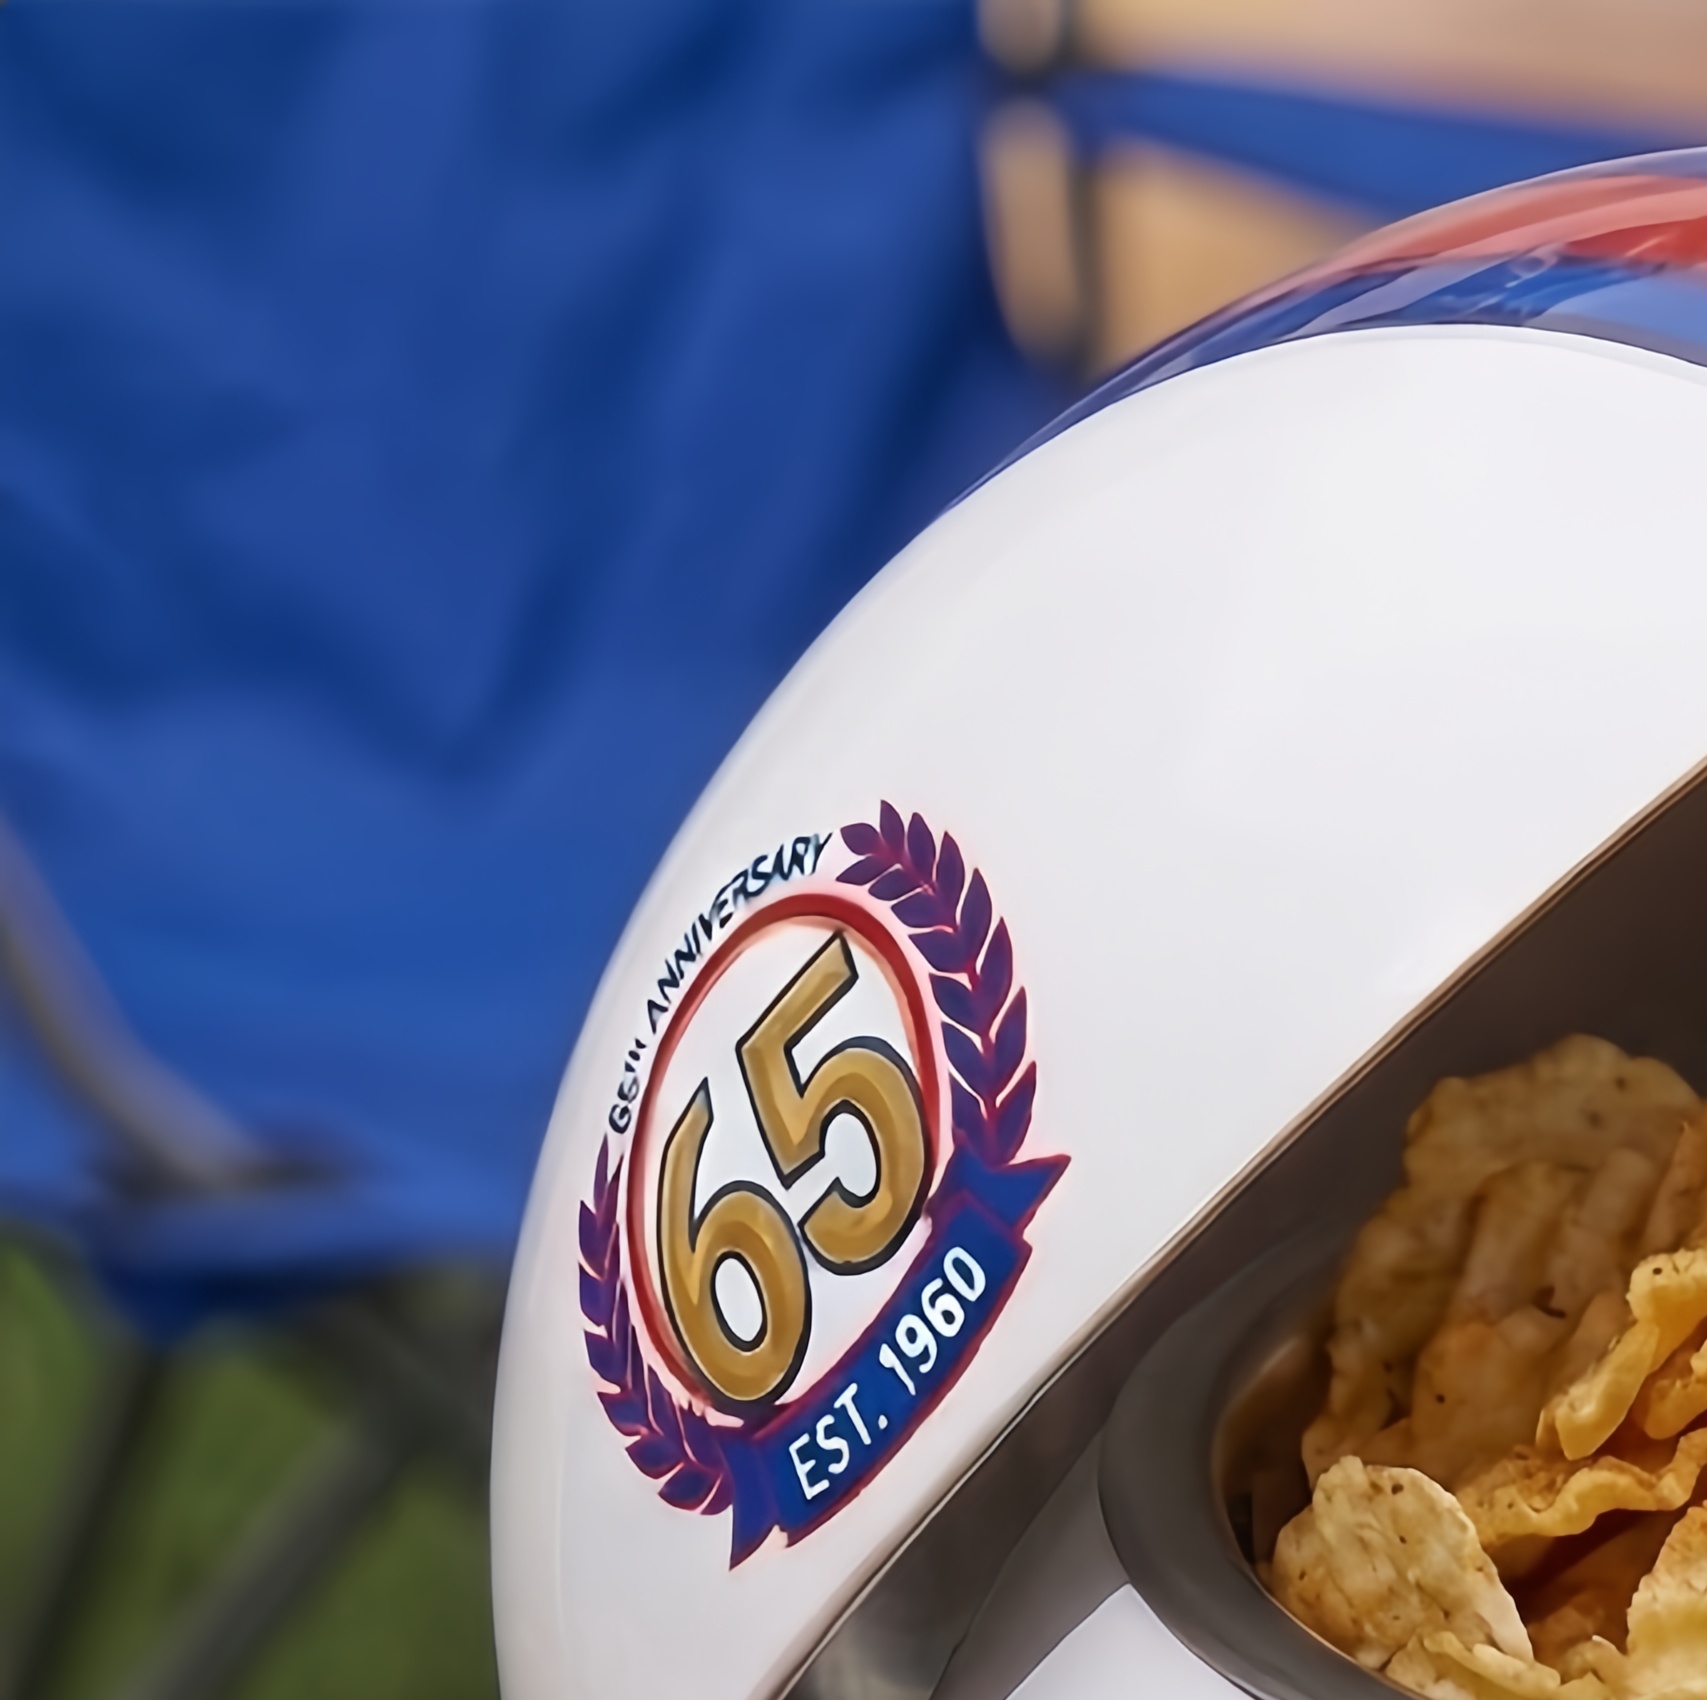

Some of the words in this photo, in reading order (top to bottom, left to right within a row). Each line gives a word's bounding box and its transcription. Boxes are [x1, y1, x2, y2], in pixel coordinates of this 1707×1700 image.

[647, 831, 833, 1035] ANNIVERSARY
[656, 930, 926, 1404] 65
[788, 1382, 889, 1500] EST.
[878, 1246, 987, 1396] 1960
